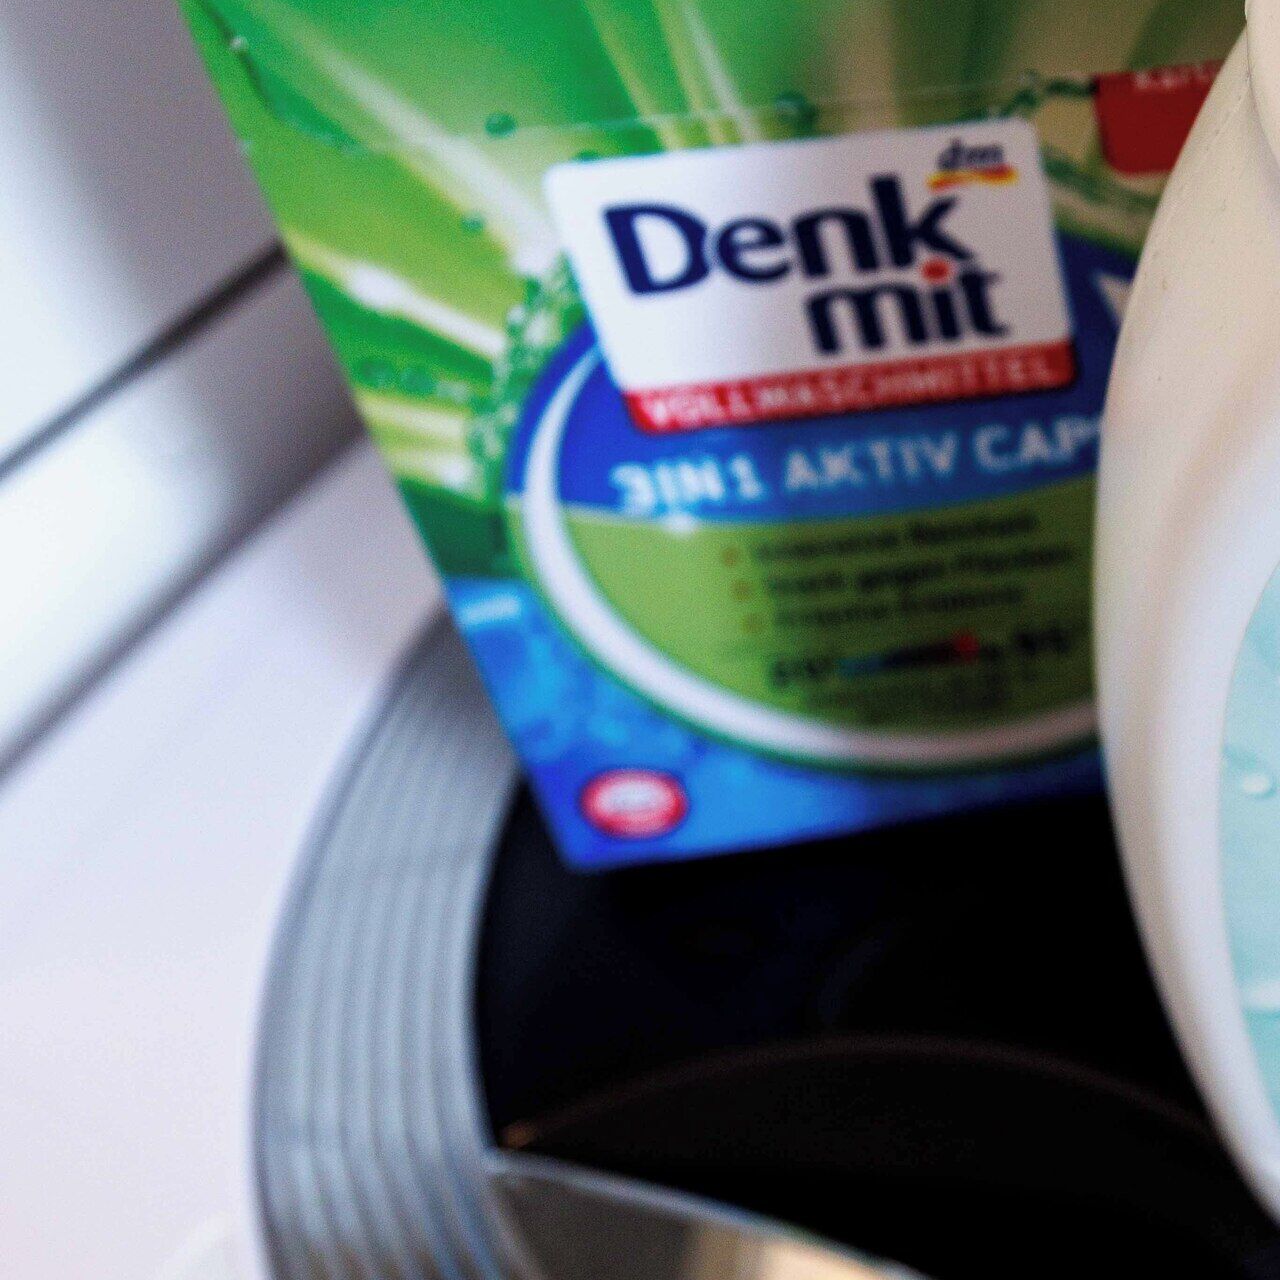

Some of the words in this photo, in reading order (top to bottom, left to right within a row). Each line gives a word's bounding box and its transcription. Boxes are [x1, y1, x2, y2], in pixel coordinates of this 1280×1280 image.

[938, 138, 1005, 174] dm
[604, 172, 973, 295] Denk
[806, 259, 1009, 355] mit
[641, 352, 1056, 426] VOLLWASCHMITTEL
[610, 455, 765, 511] 3IN1
[784, 426, 962, 494] AKTIV
[971, 415, 1101, 473] CAP
